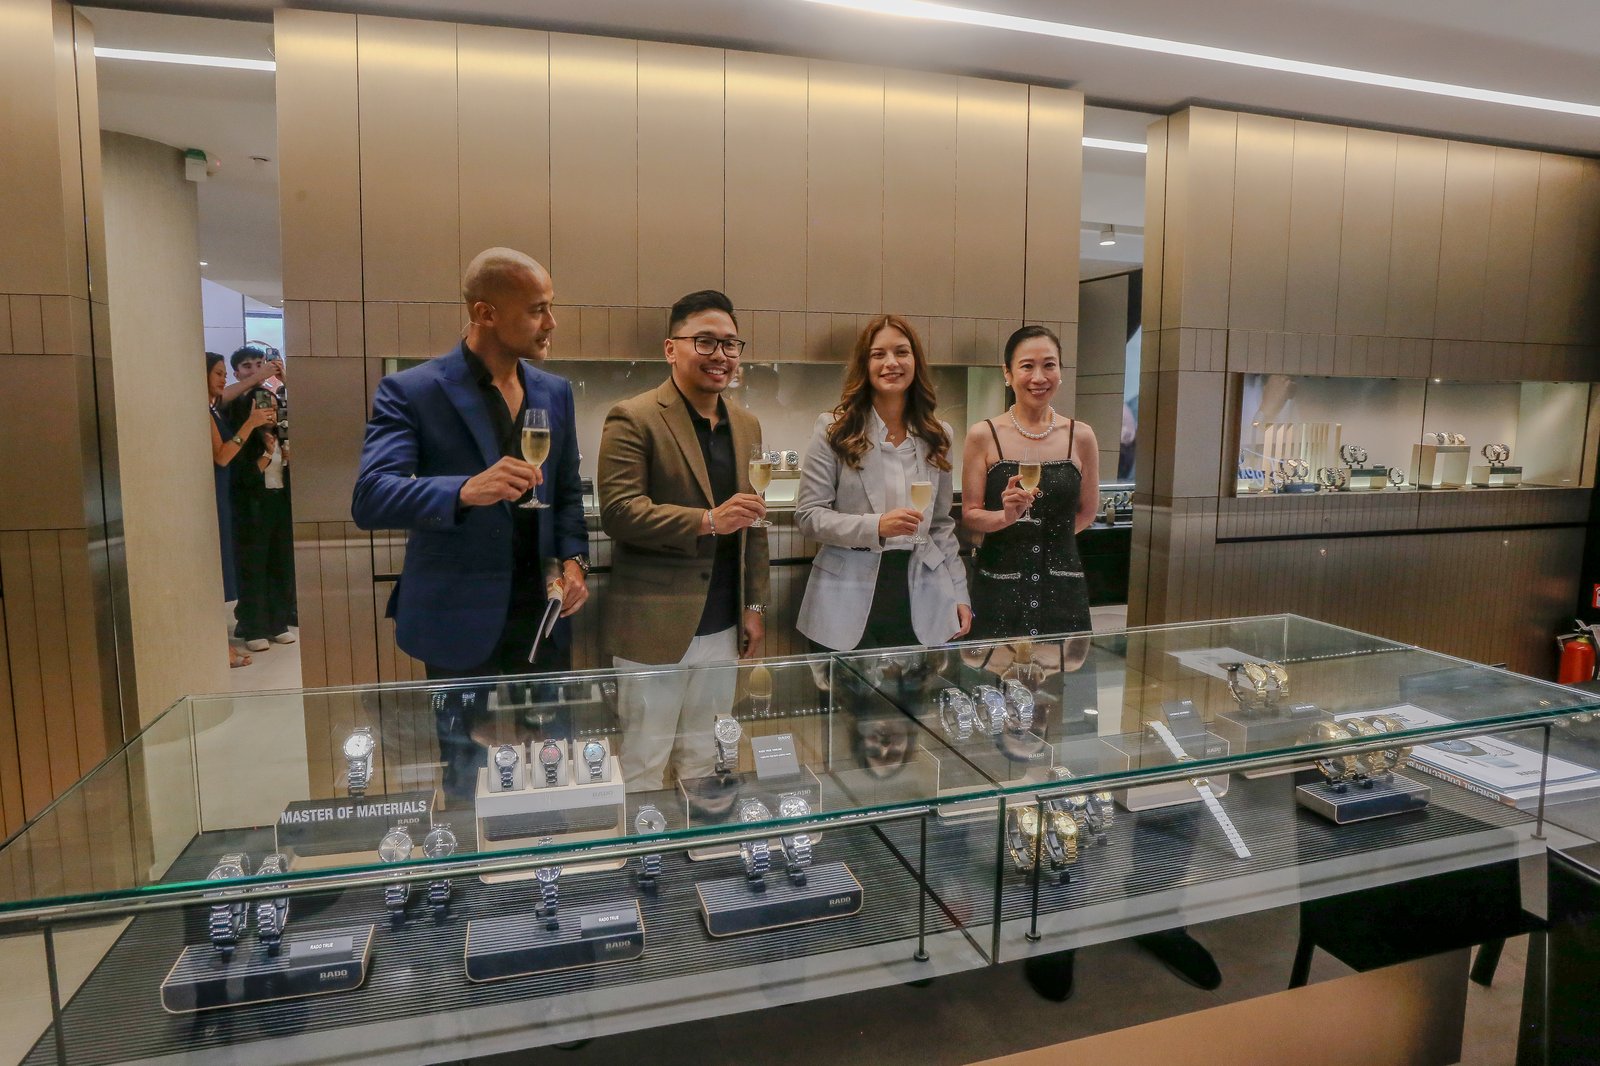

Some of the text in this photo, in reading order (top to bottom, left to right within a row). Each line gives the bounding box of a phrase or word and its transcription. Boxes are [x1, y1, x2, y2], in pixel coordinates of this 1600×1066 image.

[1415, 763, 1500, 801] GENERAL COLLECTION
[281, 800, 427, 824] MASTER OF MATERIALS
[397, 817, 420, 825] RADO
[829, 896, 851, 905] RADO
[605, 940, 631, 949] RADO
[319, 969, 348, 979] RADO
